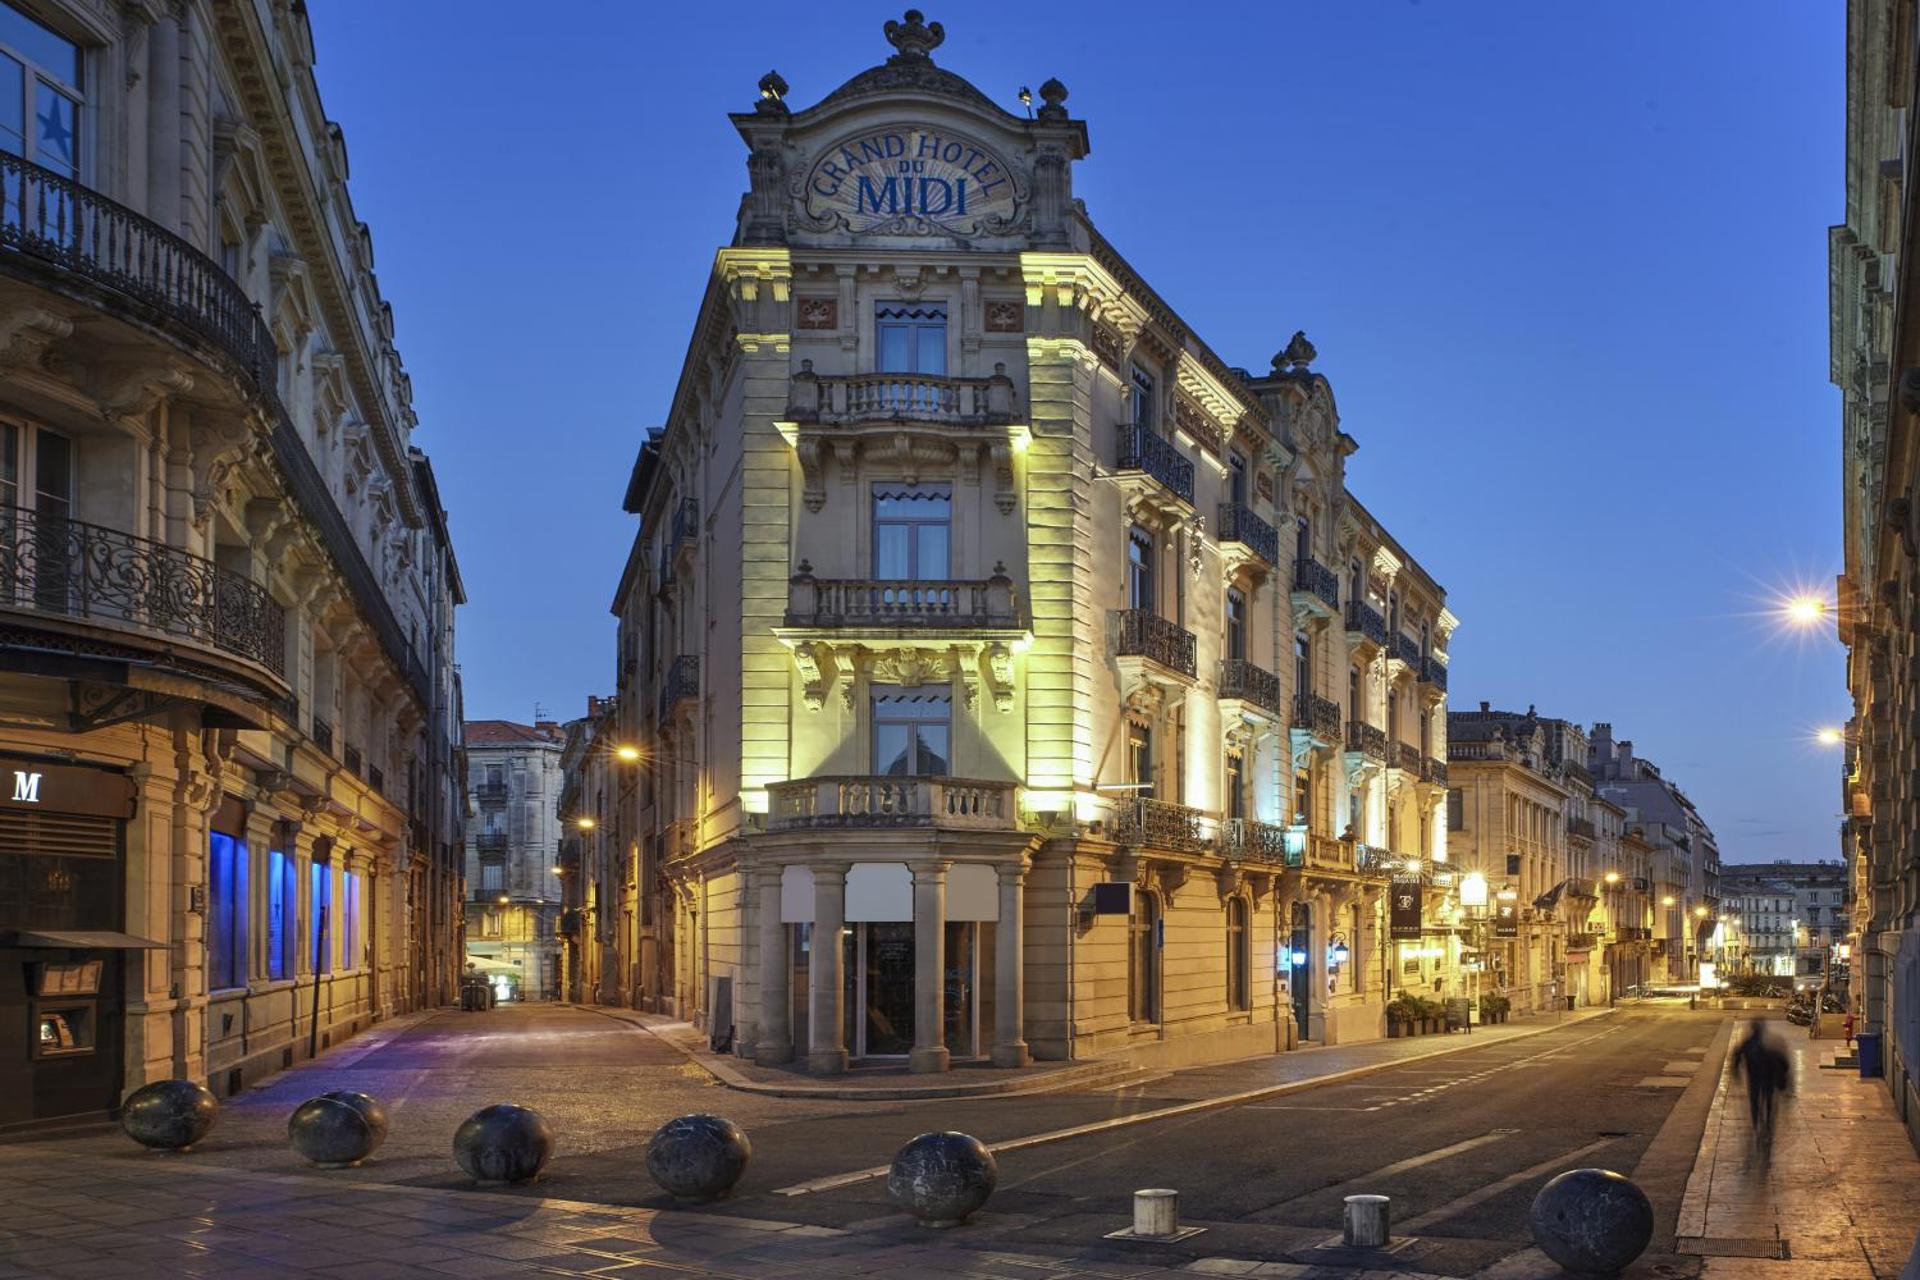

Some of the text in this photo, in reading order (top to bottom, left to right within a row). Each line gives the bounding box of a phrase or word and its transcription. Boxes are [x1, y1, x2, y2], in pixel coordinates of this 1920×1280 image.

[813, 135, 1006, 197] GRAND HOTEL
[899, 160, 924, 173] DU
[857, 175, 967, 215] MIDI
[11, 771, 42, 802] M
